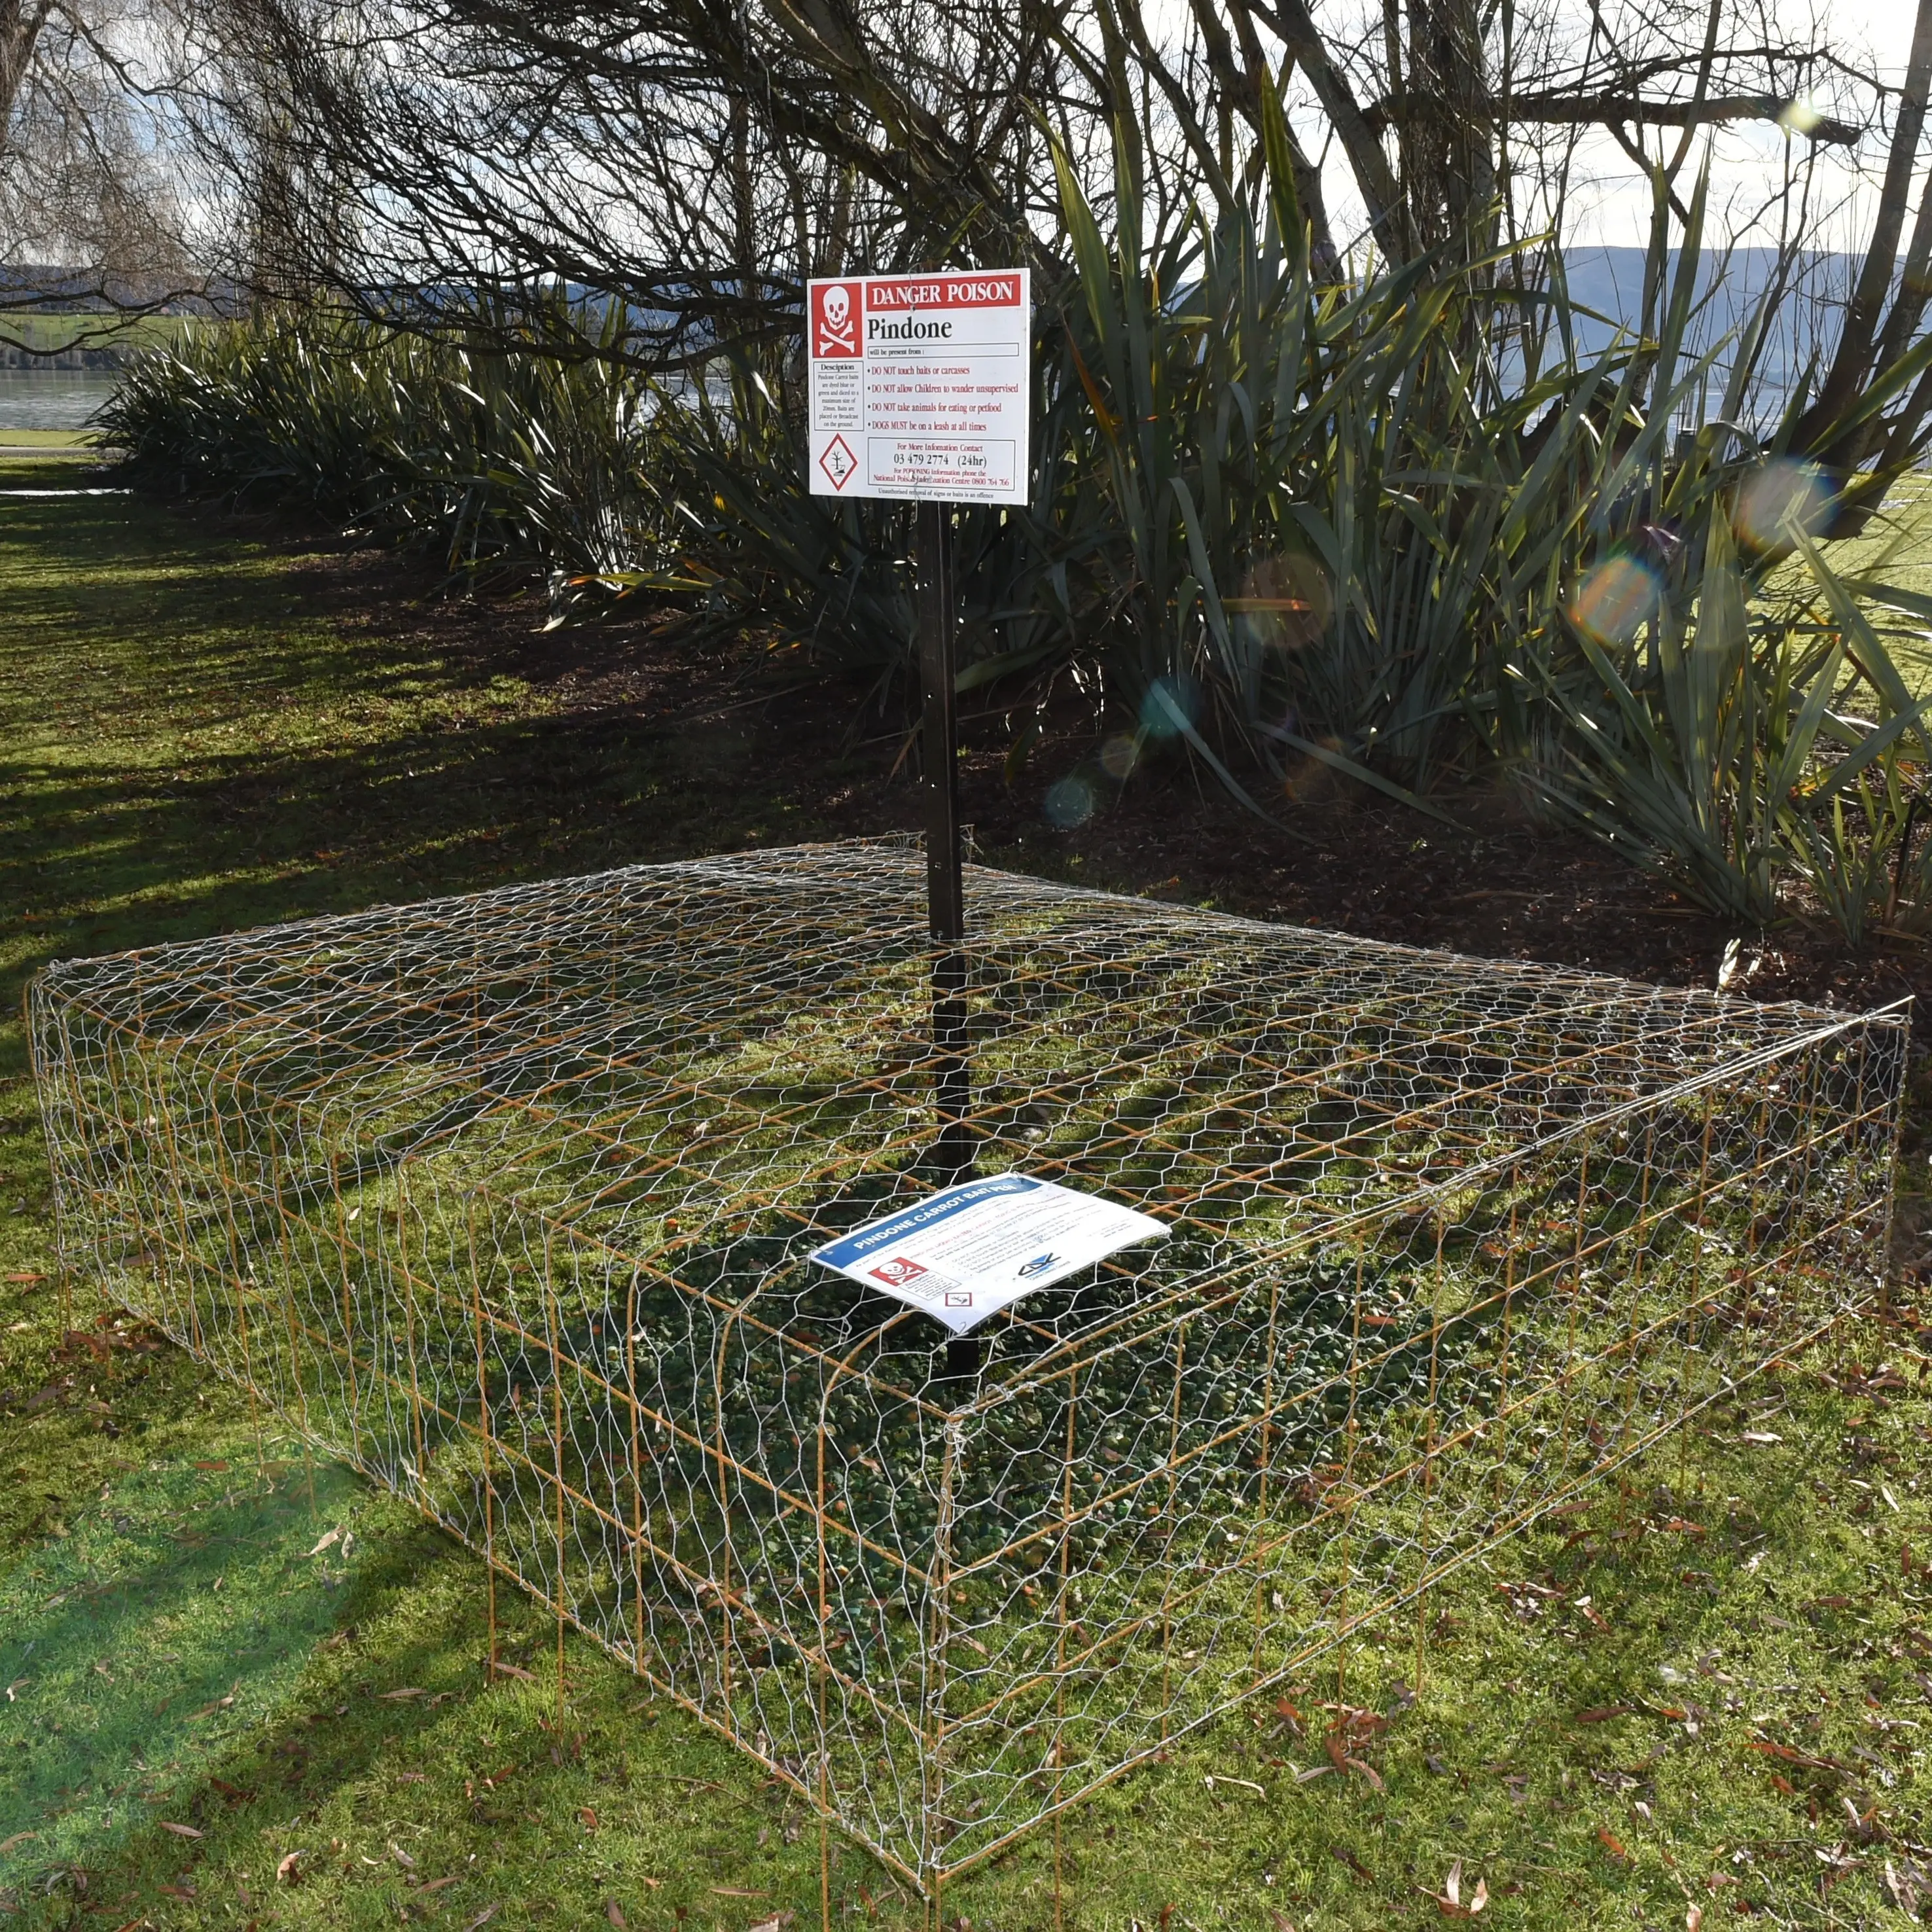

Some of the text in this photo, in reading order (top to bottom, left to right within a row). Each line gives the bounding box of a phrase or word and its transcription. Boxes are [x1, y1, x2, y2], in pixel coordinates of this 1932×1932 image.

[872, 281, 1013, 306] DANGER POISON
[868, 316, 952, 340] Pindone
[821, 364, 854, 372] Desciption
[915, 384, 941, 393] Children
[952, 384, 974, 393] wander
[976, 384, 1018, 395] unsupervised
[912, 403, 936, 412] animals
[949, 404, 967, 414] eating
[978, 403, 1001, 414] petfood
[891, 421, 907, 430] MUST
[910, 421, 916, 430] be
[934, 421, 949, 430] leash
[969, 422, 986, 431] times
[894, 453, 986, 468] 03 479 2774 (24hr)
[853, 1184, 1017, 1250] PINDONE CARROT BAIT PEN
